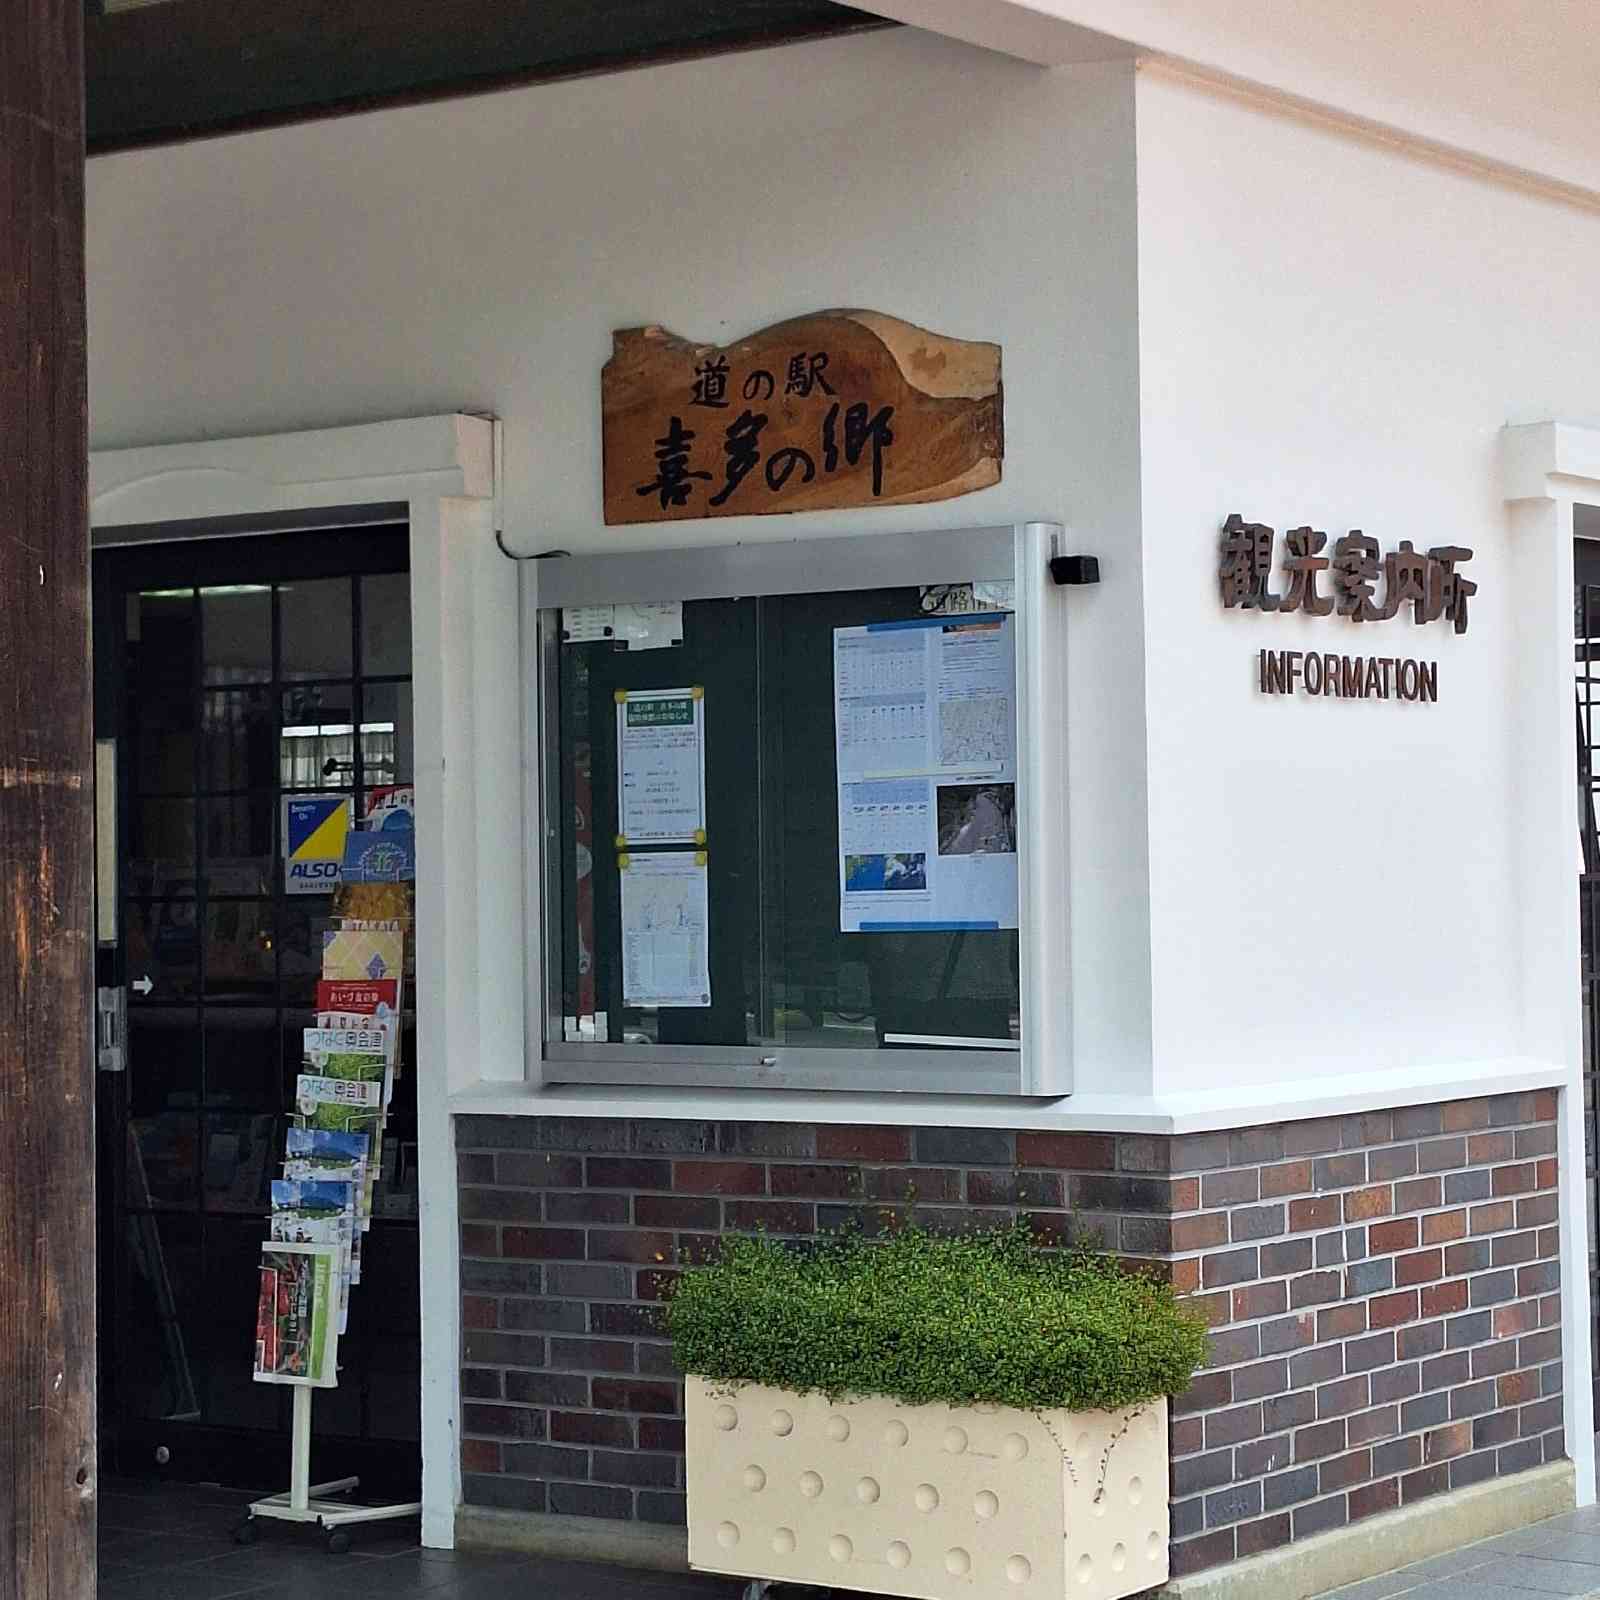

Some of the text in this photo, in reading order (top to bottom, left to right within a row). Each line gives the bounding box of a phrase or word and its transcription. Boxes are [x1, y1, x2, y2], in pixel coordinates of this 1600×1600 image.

[688, 351, 835, 408] 道の駅
[636, 402, 894, 510] 喜多の郷
[1218, 513, 1478, 635] 観光案内所
[1258, 648, 1438, 703] INFORMATION
[290, 862, 343, 878] ALSO
